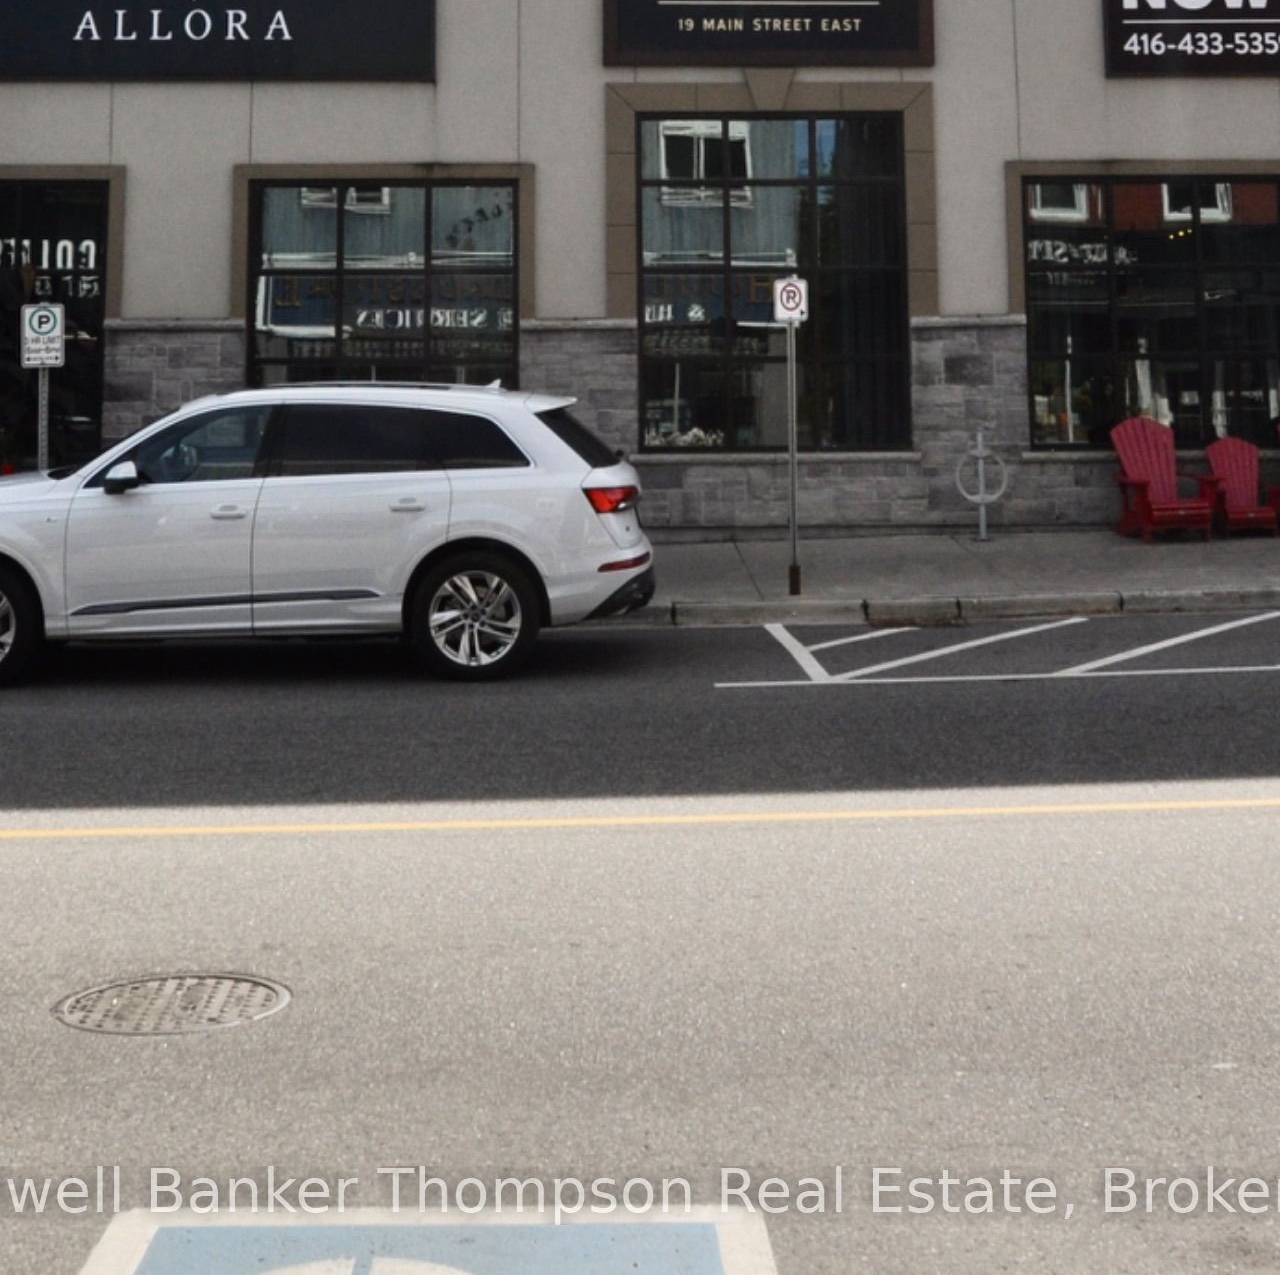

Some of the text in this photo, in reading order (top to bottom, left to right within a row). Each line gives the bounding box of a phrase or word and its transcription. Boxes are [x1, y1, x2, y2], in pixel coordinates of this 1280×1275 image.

[73, 10, 293, 40] ALLORA
[678, 19, 862, 31] 19 MAIN STREET EAST
